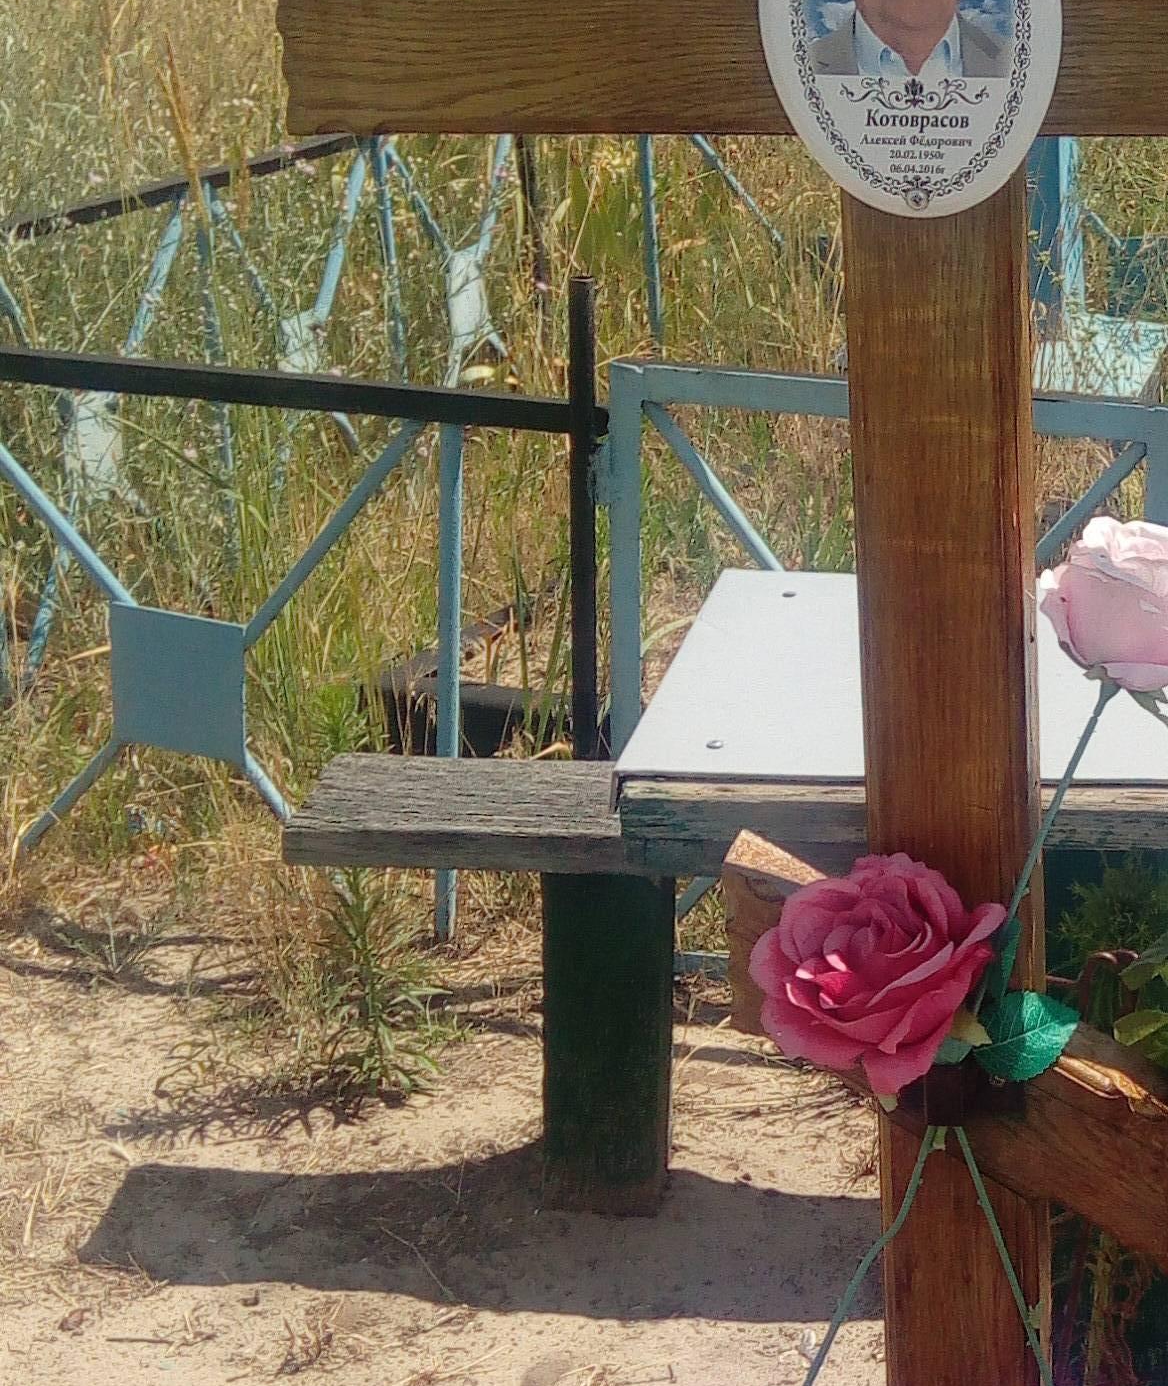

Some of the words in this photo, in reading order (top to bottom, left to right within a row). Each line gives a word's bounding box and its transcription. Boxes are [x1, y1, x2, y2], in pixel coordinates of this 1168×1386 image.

[865, 108, 970, 133] Котоврасов
[860, 134, 907, 146] Алексей
[909, 133, 973, 149] Фёдорович
